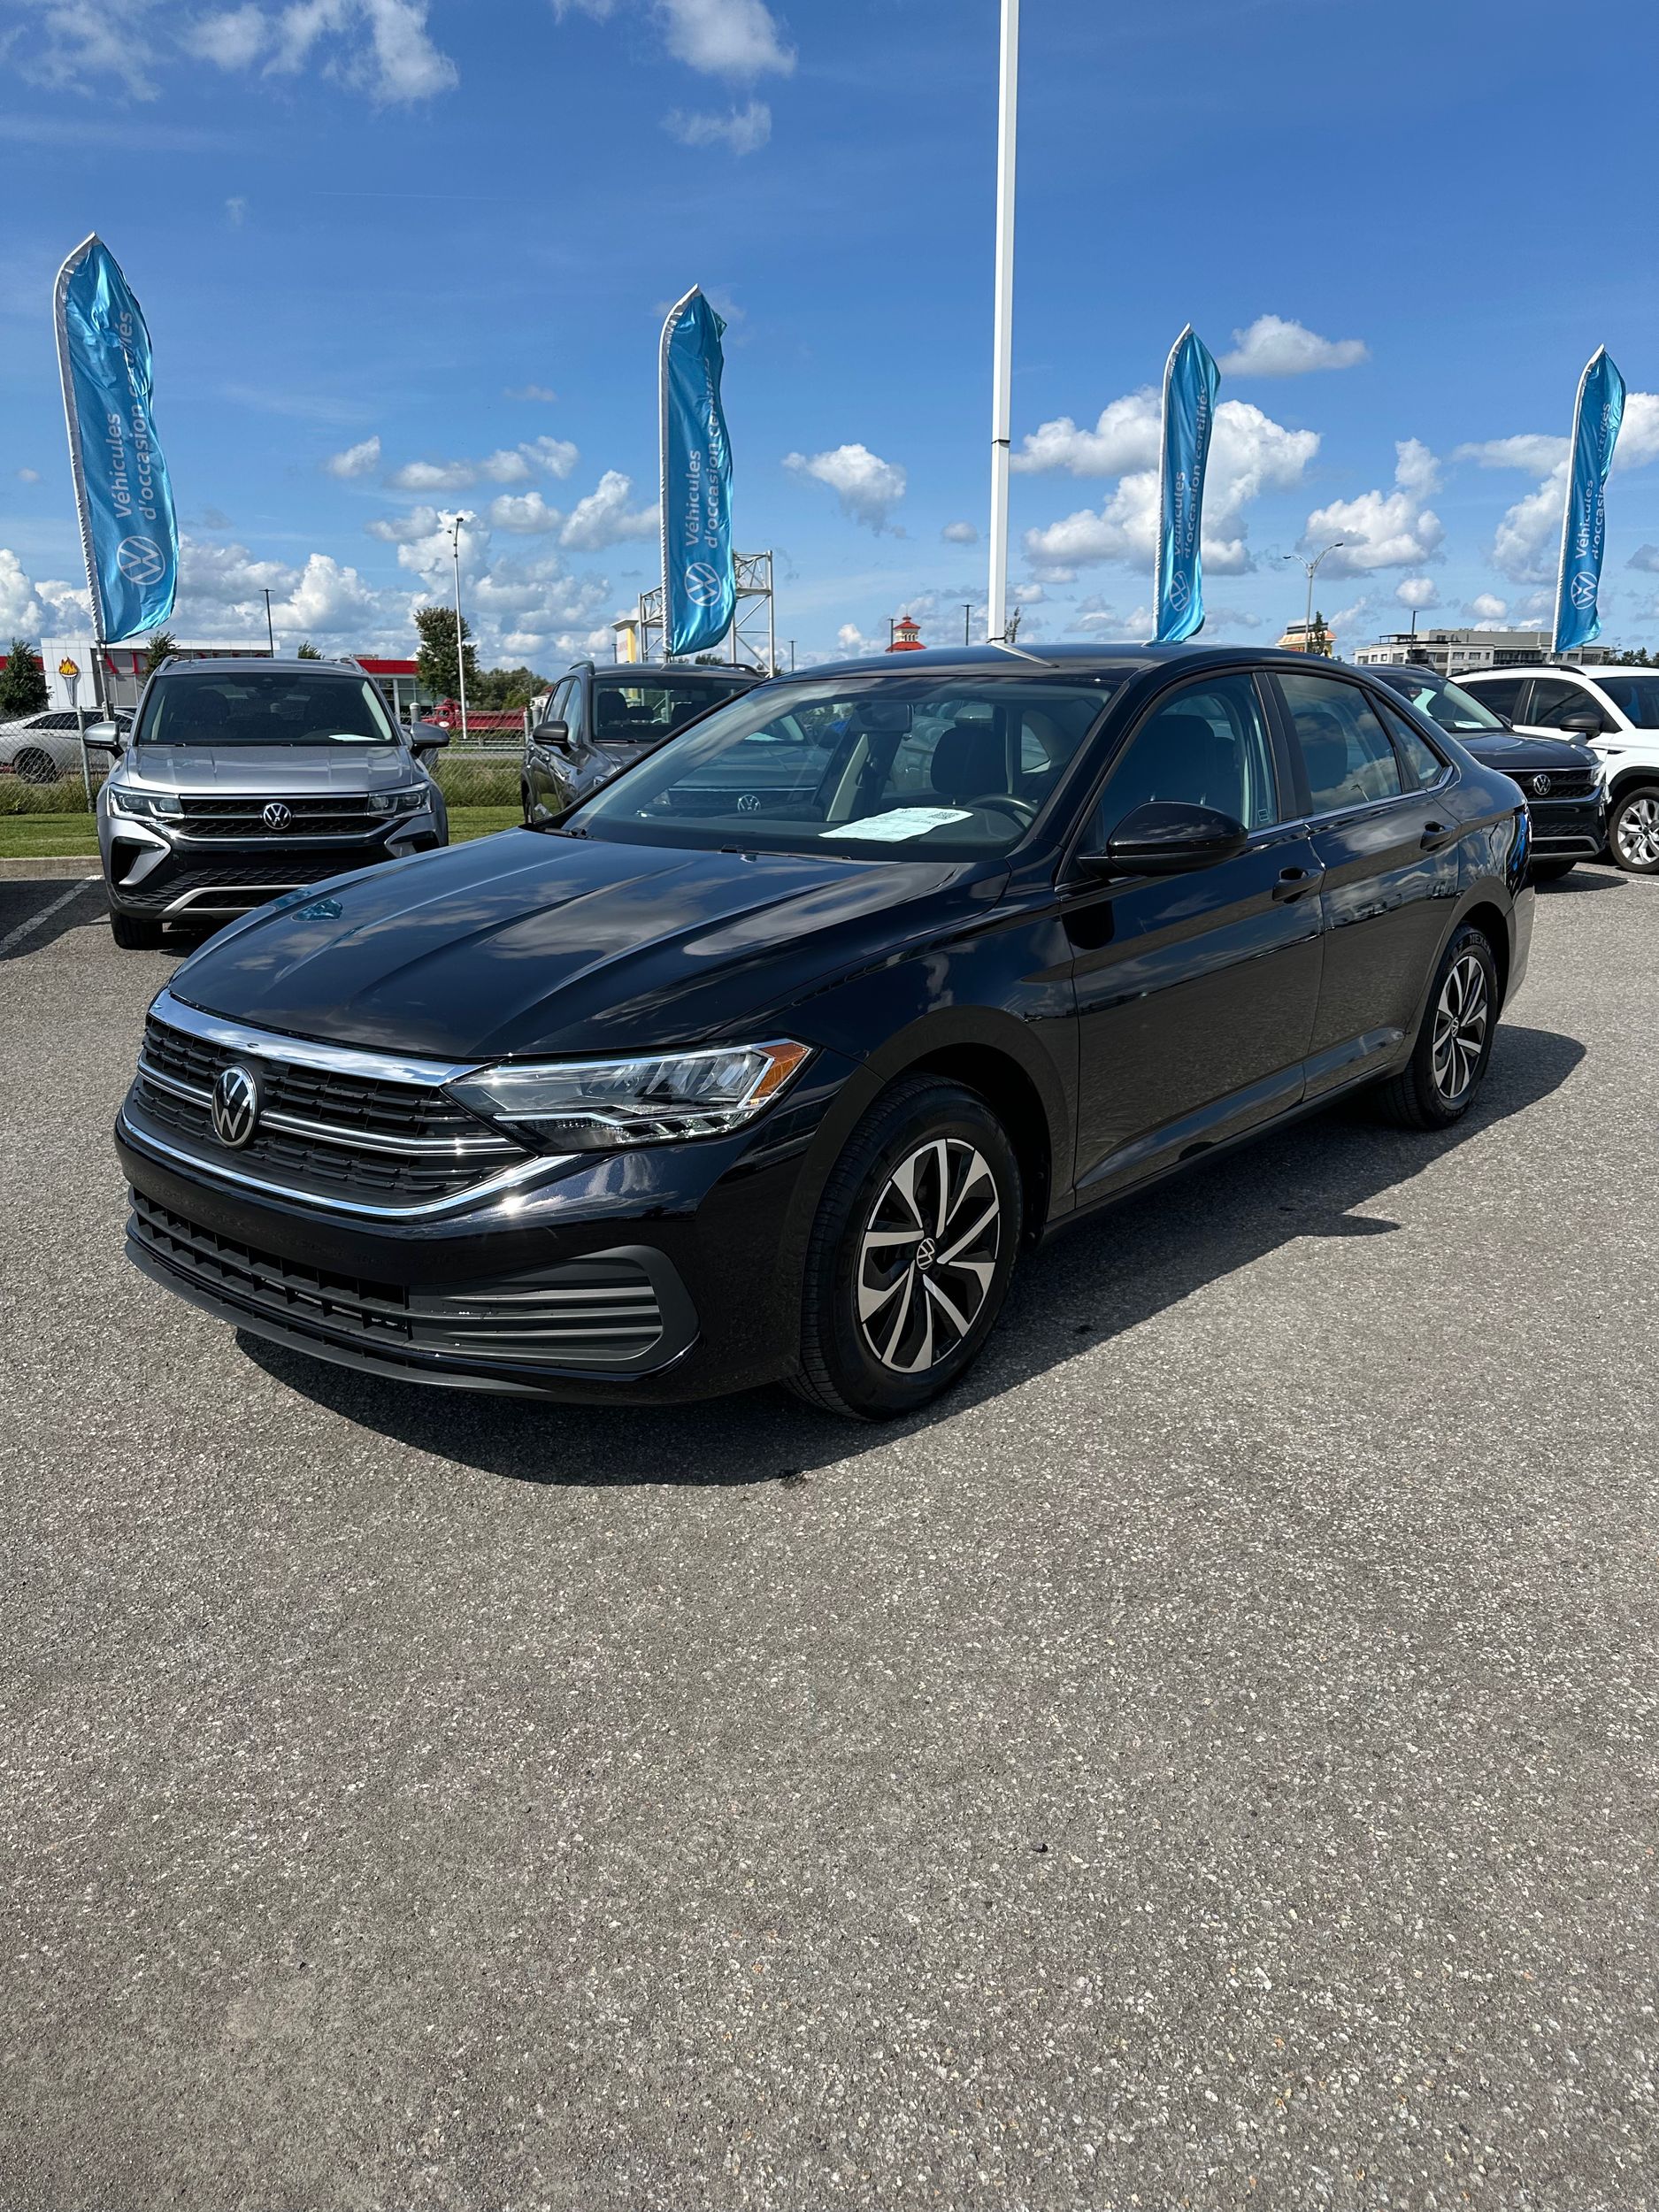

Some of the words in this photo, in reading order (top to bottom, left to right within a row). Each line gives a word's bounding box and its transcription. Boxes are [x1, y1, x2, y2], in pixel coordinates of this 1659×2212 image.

[106, 413, 132, 518] Véhicules
[128, 404, 157, 520] d'occasion
[685, 449, 701, 546] Véhicules
[704, 442, 719, 549] d'occasion
[1575, 480, 1594, 559] Véhicules
[1591, 483, 1604, 560] d'occasi
[117, 536, 165, 584] VW
[684, 563, 720, 605] VW
[264, 803, 291, 829] VW
[1533, 774, 1550, 795] VW
[1469, 933, 1492, 956] NEXEN
[213, 1067, 255, 1146] VW
[917, 1238, 935, 1270] VW
